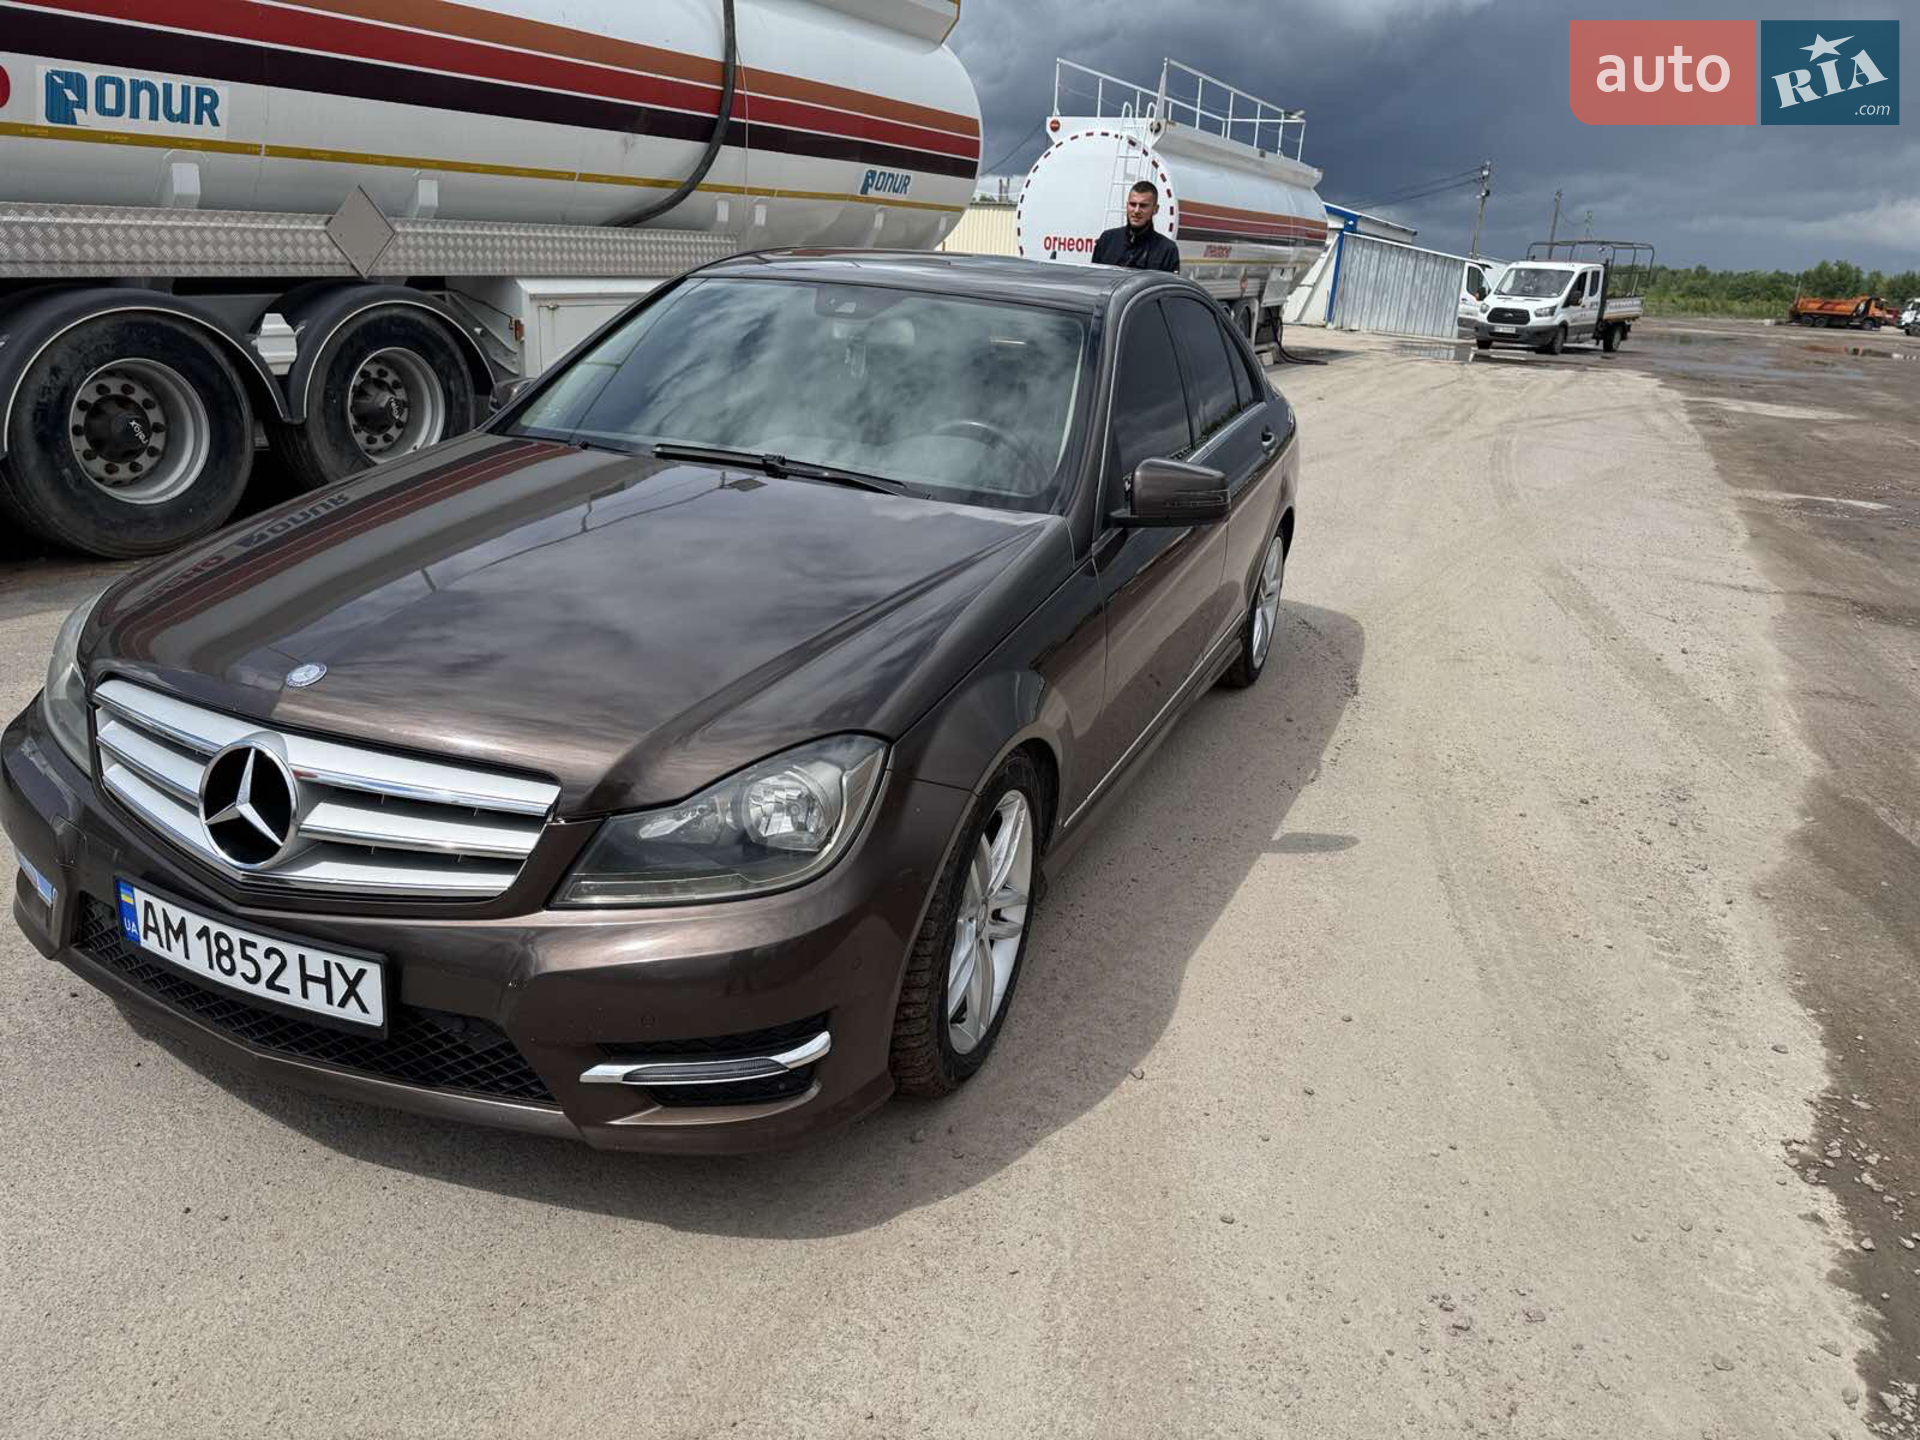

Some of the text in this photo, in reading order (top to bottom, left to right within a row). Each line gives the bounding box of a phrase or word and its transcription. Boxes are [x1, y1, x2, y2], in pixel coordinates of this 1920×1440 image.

[95, 75, 220, 127] ONUR
[874, 171, 911, 195] ONUR
[1044, 236, 1094, 253] огнеоп
[124, 918, 138, 936] UA
[143, 899, 370, 1015] AM 1852 HX
